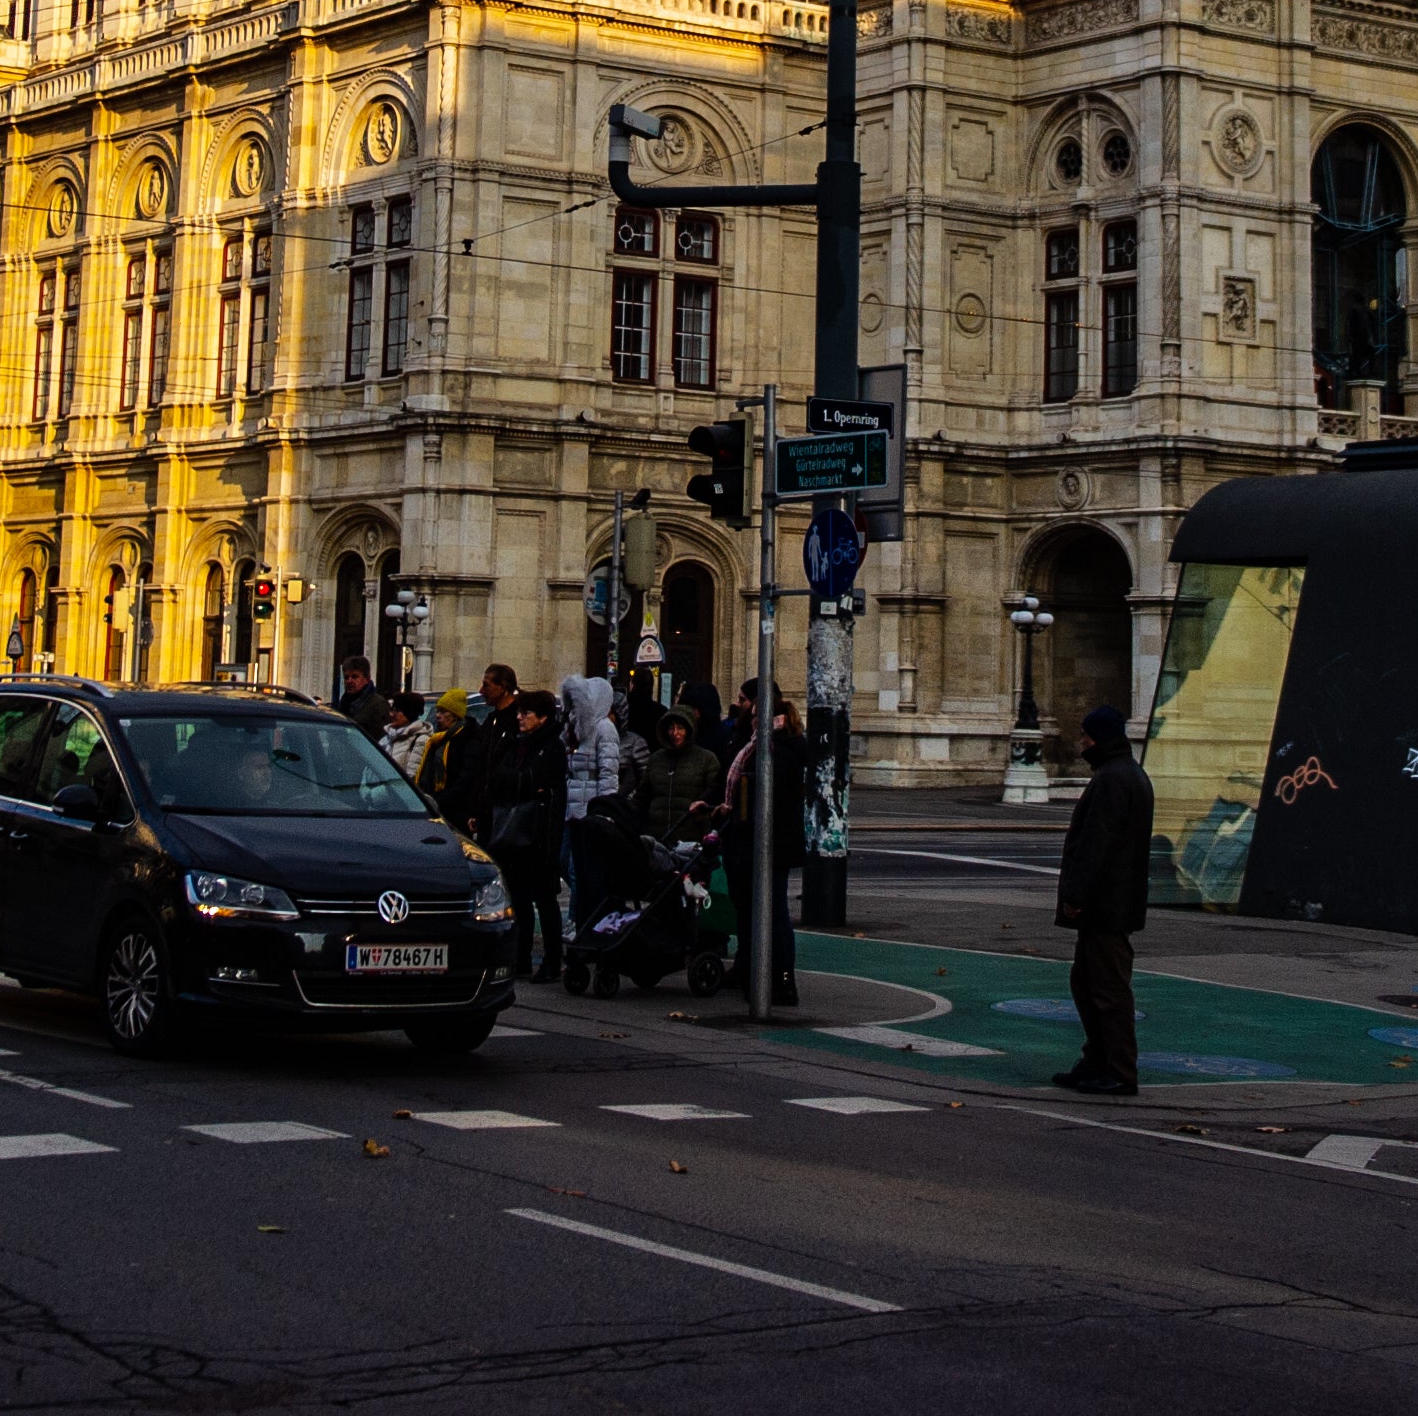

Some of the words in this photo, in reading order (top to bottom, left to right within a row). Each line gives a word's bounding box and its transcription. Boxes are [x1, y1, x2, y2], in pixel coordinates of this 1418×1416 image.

[823, 408, 833, 422] 1.
[834, 409, 879, 428] Opernring
[788, 441, 854, 457] Wientalradweg
[795, 457, 846, 472] Gürtelradweg
[798, 473, 843, 487] Naschmarkt
[359, 948, 371, 967] W
[383, 948, 431, 967] 78467
